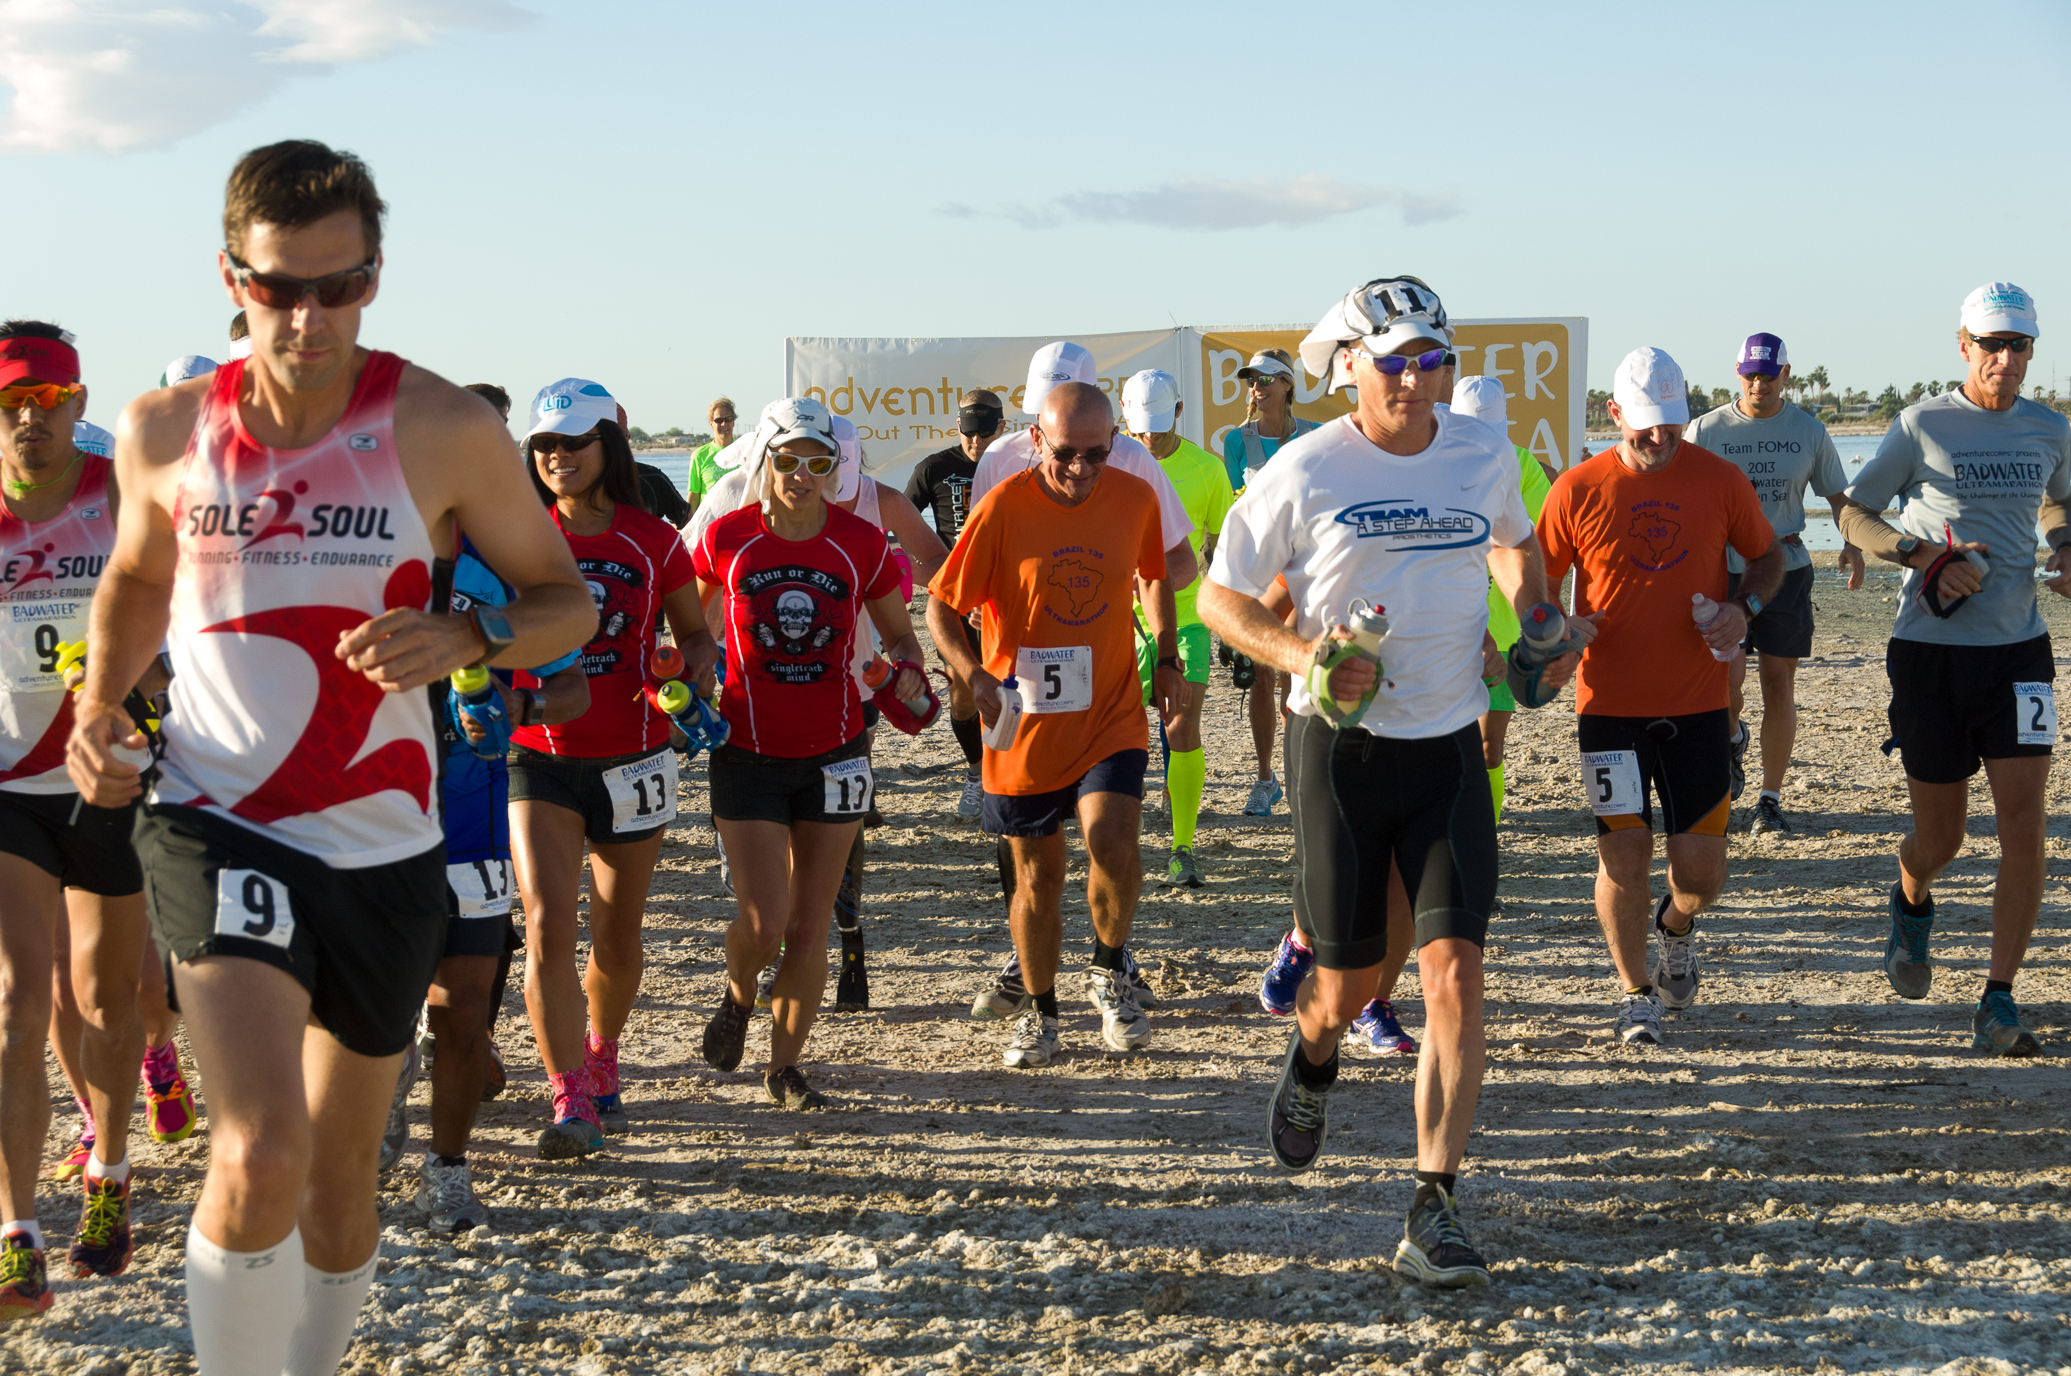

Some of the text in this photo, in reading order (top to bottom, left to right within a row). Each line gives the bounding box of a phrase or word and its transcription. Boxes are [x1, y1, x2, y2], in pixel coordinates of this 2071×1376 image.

[1374, 287, 1428, 321] 11
[856, 425, 900, 440] Out
[909, 425, 959, 440] The
[1721, 441, 1801, 454] Team FOMO
[2015, 450, 2041, 458] presents
[1748, 461, 1775, 473] 2013
[1953, 462, 2043, 481] BADWATER
[1752, 476, 1787, 488] water
[1956, 480, 2044, 489] ULTRAMARATHON
[1970, 492, 1999, 500] Challenge
[1351, 507, 1429, 522] TEAM
[1630, 501, 1681, 513] BRAZIL 135
[188, 503, 259, 537] SOLE
[307, 503, 395, 540] SOUL
[1356, 517, 1473, 534] A STEP AHEAD
[1646, 526, 1668, 538] 135
[188, 551, 394, 568] UNNING FITNESS ENDURANCE
[1052, 546, 1104, 560] BRAZIL 135
[55, 555, 110, 581] SOU
[579, 561, 632, 579] or Die
[747, 569, 838, 593] Run or Die
[1067, 576, 1090, 588] 135
[10, 587, 96, 601] FITNESS ENDUR
[13, 602, 76, 618] BADWATER
[1044, 602, 1109, 627] ULTRAMARATHON
[34, 624, 60, 673] 9
[1030, 649, 1075, 660] BADWATER
[579, 653, 616, 666] letrack
[770, 663, 823, 674] singletrack
[19, 674, 63, 684] adventurec
[786, 672, 811, 682] mind
[1044, 664, 1061, 700] 5
[2029, 696, 2047, 731] 2
[621, 755, 664, 777] BADWATER
[1595, 767, 1612, 803] 5
[632, 773, 665, 815] 13
[473, 860, 507, 901] 13
[242, 873, 275, 937] 9
